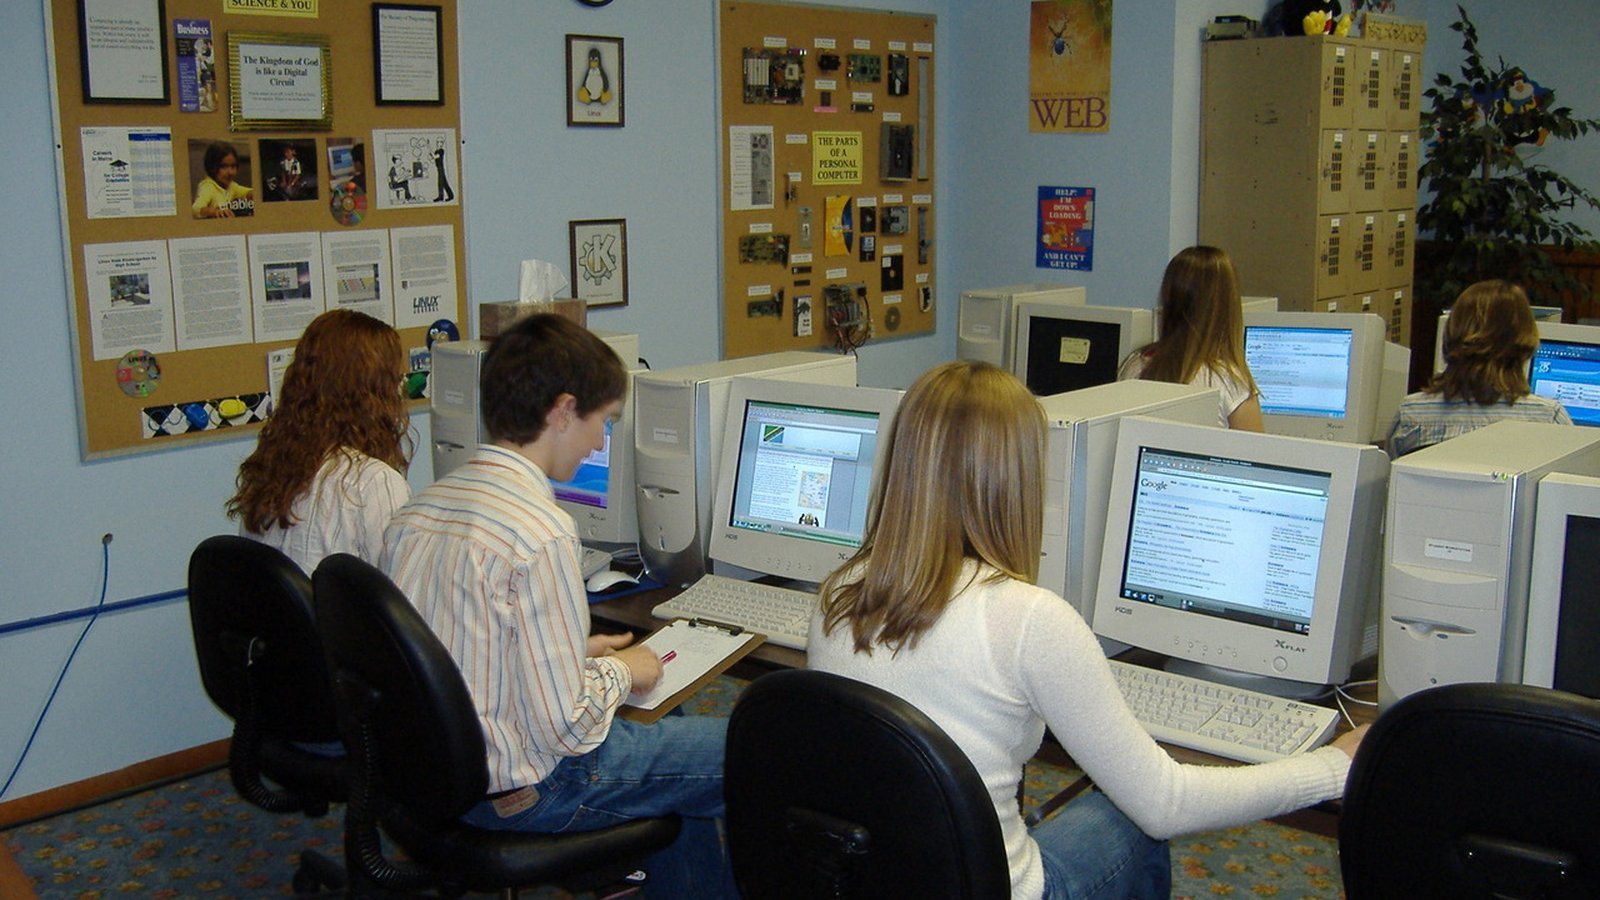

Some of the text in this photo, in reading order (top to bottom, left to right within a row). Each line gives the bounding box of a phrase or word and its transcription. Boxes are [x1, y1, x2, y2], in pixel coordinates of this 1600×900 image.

[231, 0, 277, 8] SCIENCE
[290, 0, 312, 10] YOU
[177, 22, 209, 35] Business
[243, 56, 319, 66] The Kingdom of God
[255, 67, 262, 75] is
[263, 67, 276, 75] like
[284, 68, 308, 77] Digital
[269, 78, 295, 86] Circuit
[1030, 97, 1107, 128] WEB
[818, 137, 858, 146] THE PARTS
[830, 148, 847, 157] OF A
[819, 160, 858, 169] PERSONAL
[817, 171, 859, 180] COMPUTER
[219, 198, 254, 210] enable
[1044, 252, 1059, 260] AND
[413, 296, 438, 308] LINUX
[1141, 478, 1168, 491] Google
